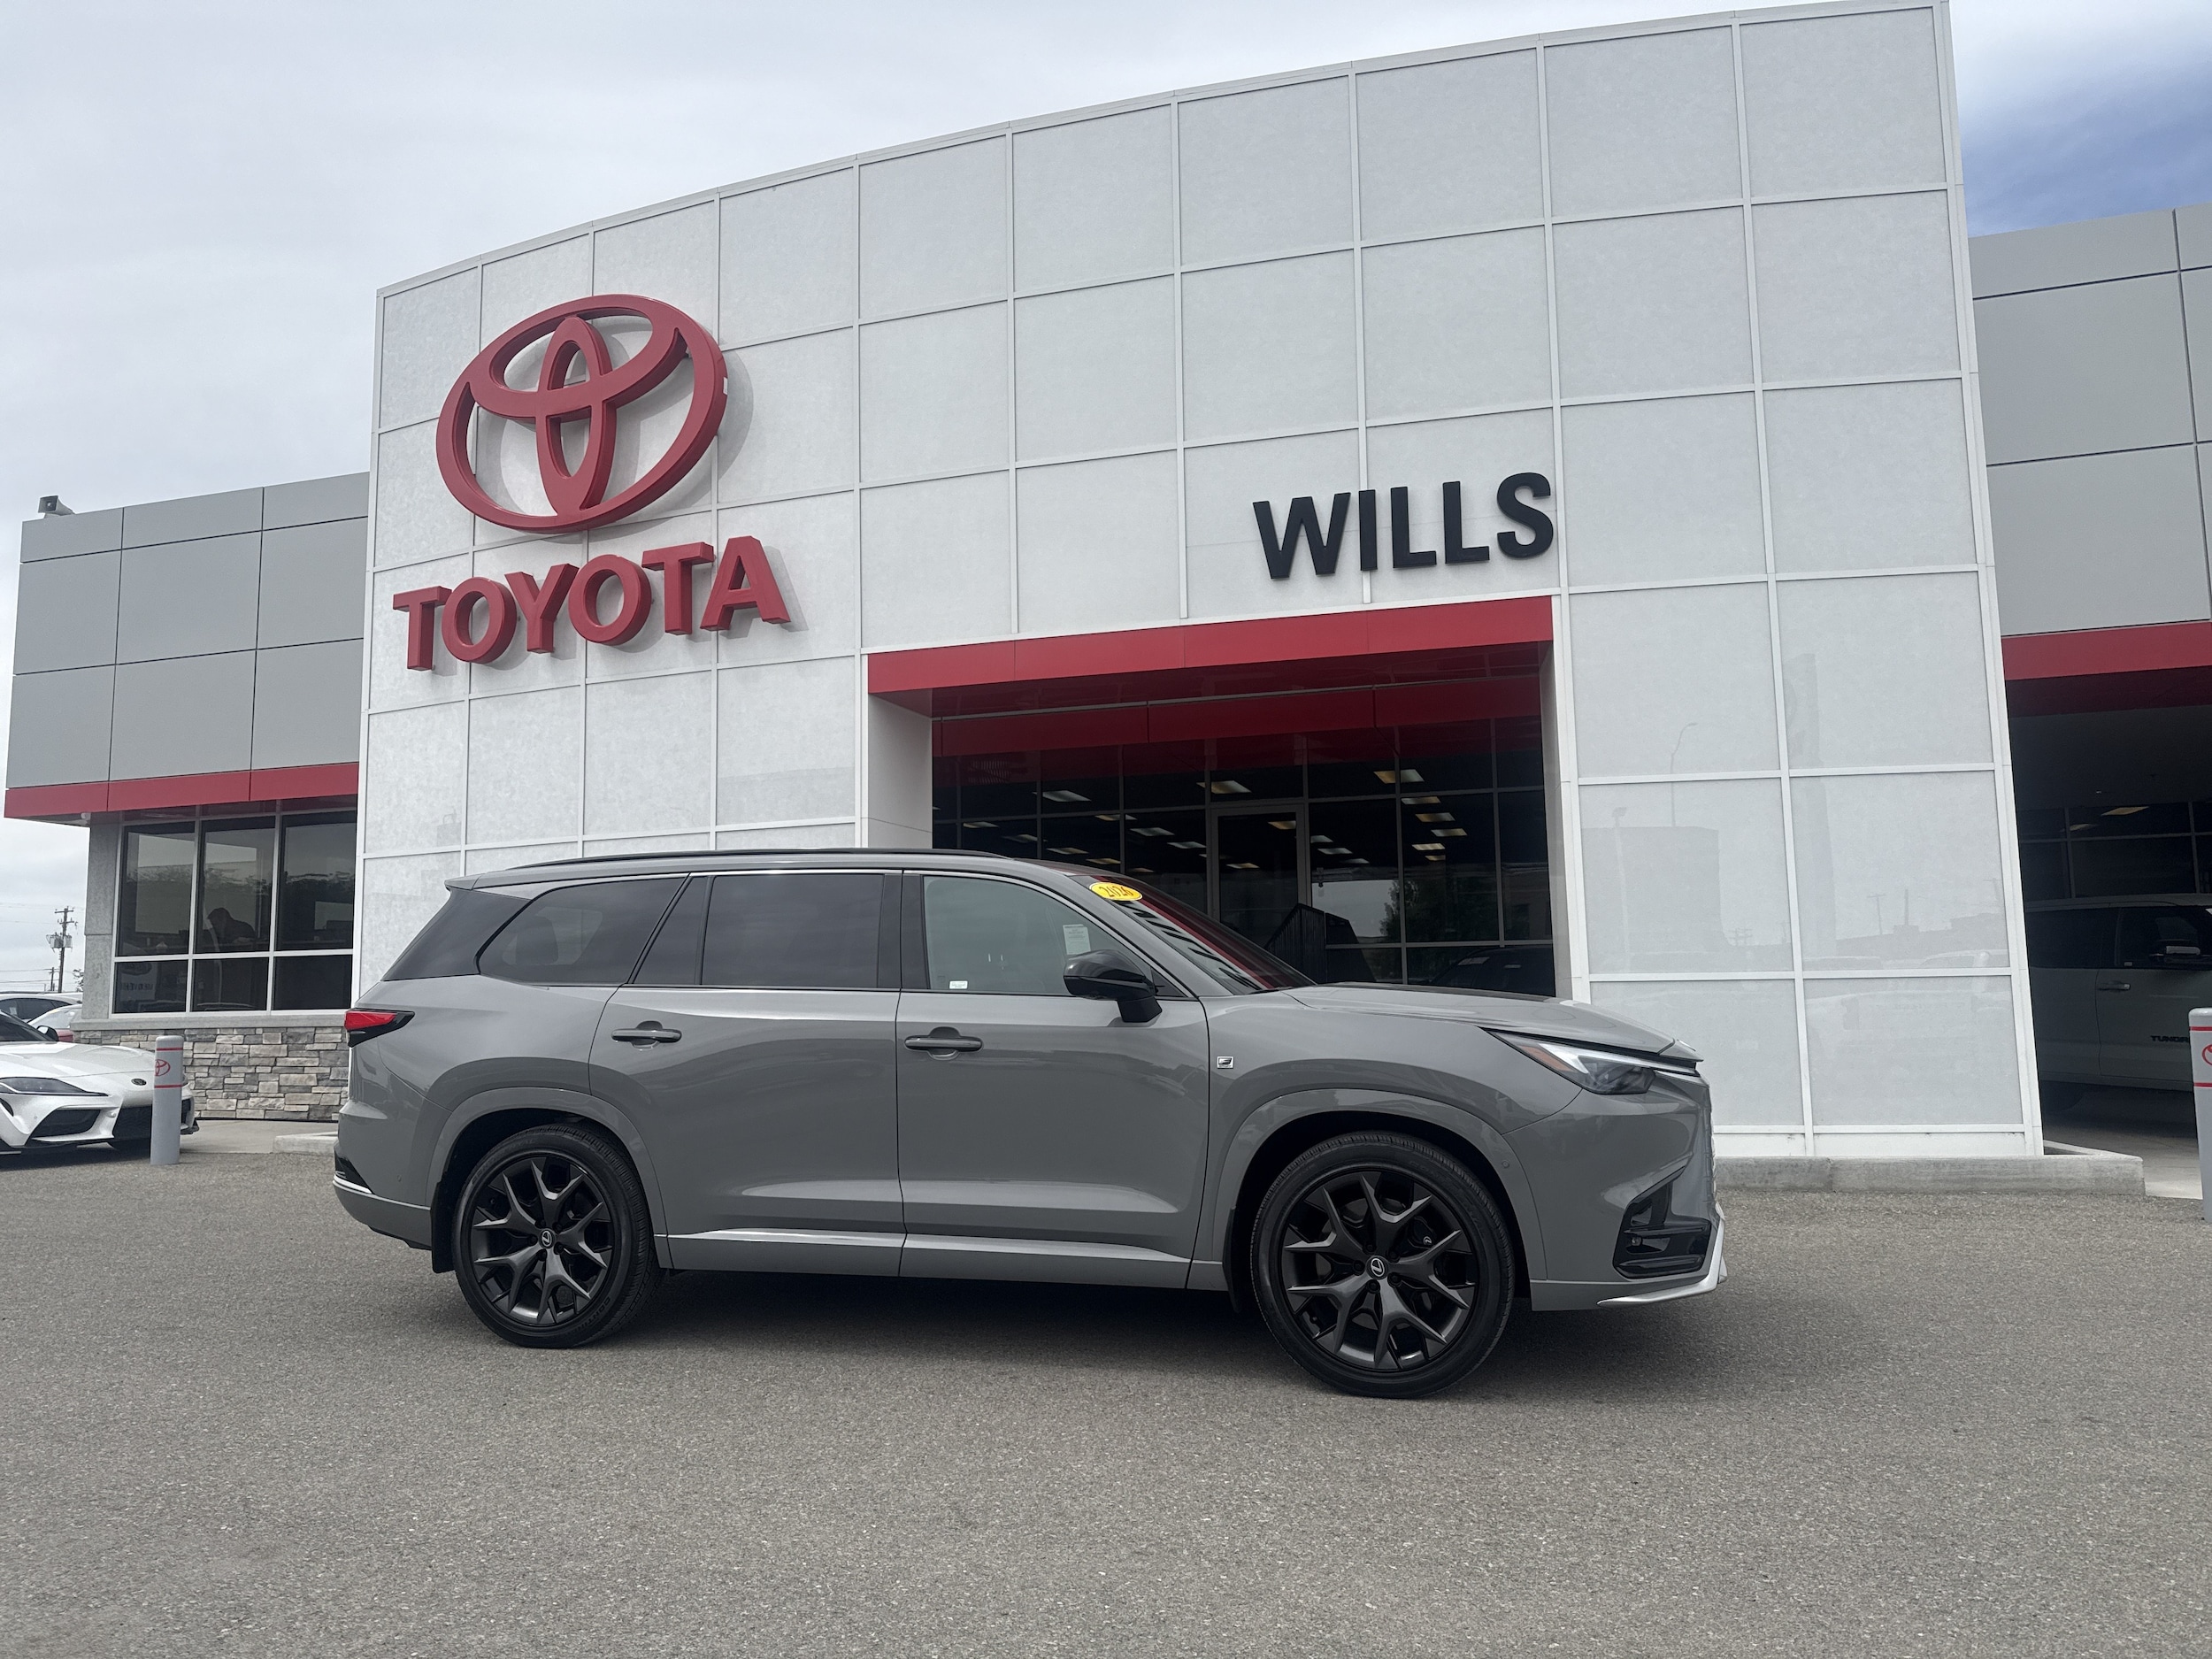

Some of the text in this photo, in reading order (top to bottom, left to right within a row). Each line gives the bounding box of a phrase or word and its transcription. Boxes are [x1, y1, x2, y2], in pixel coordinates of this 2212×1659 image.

[1252, 472, 1554, 580] WILLS
[393, 535, 791, 672] TOYOTA
[2150, 1034, 2189, 1043] TUNDR
